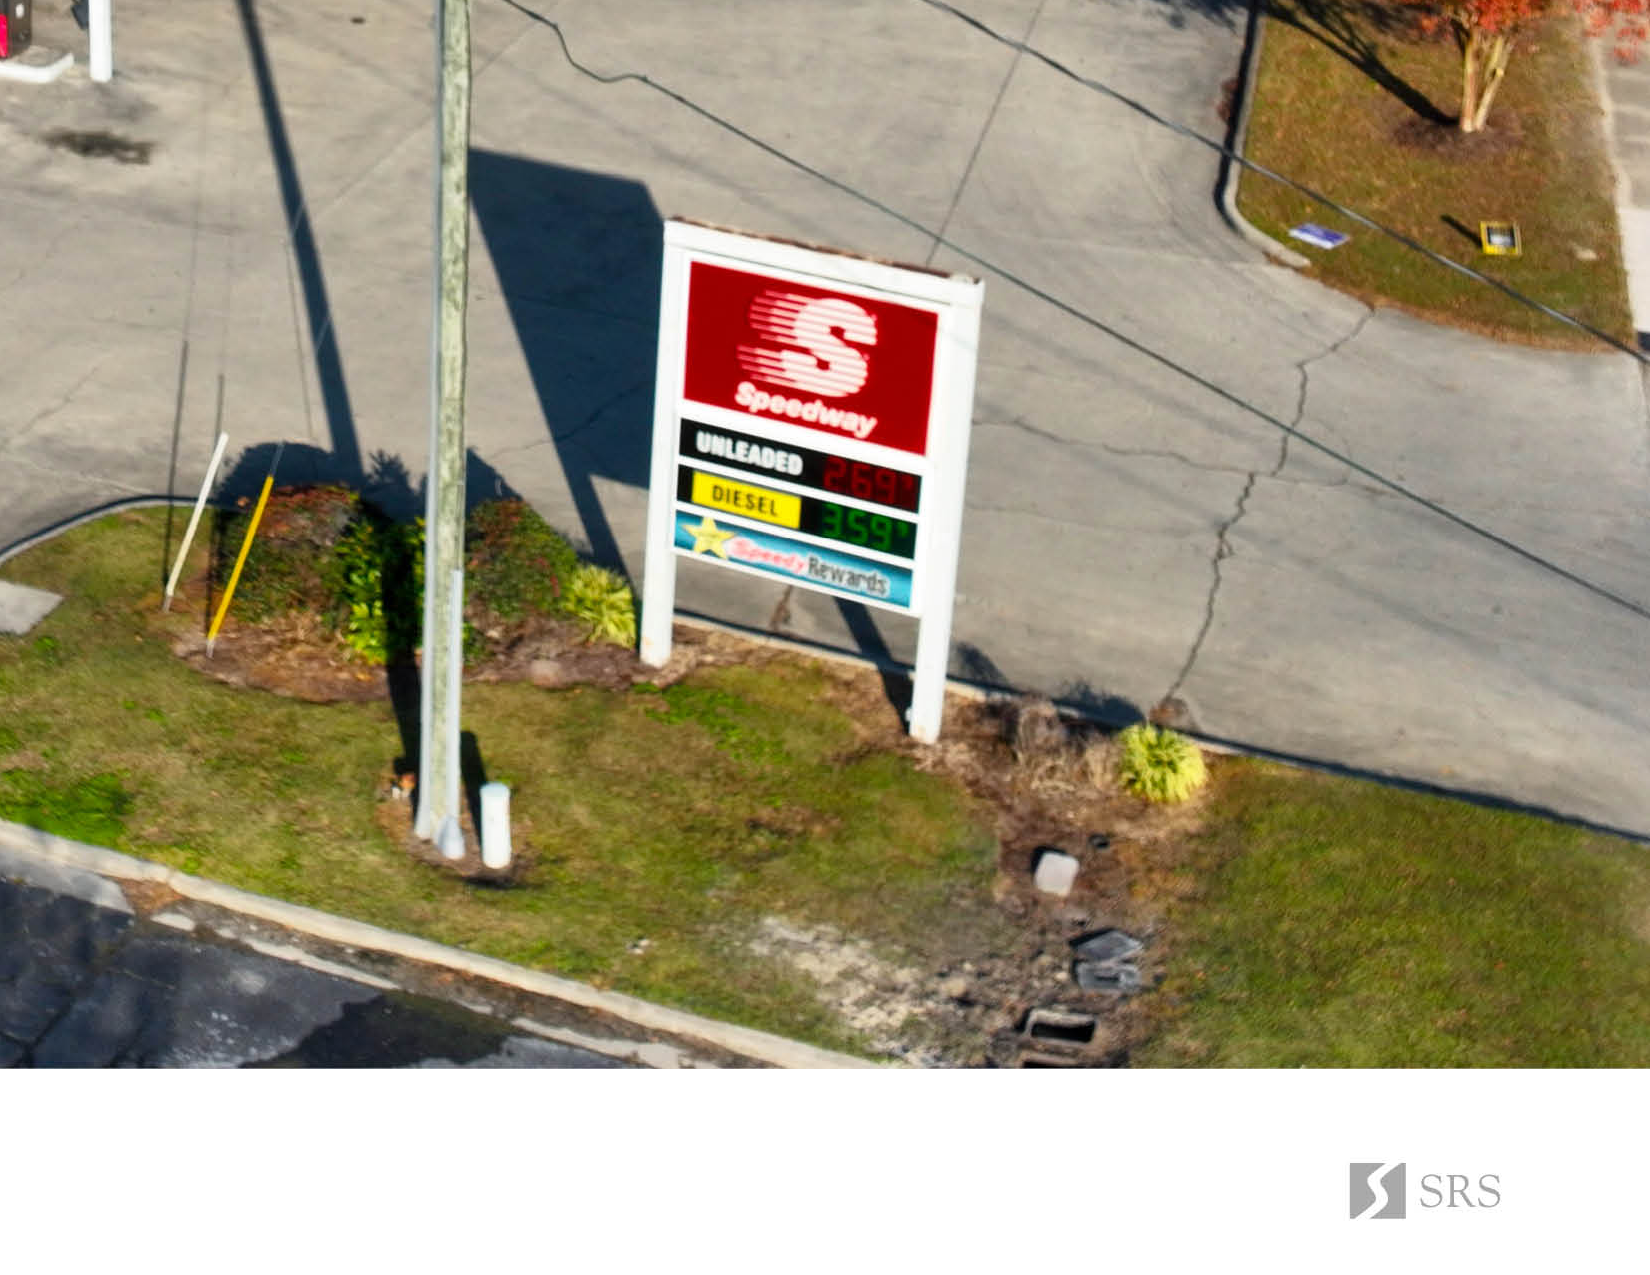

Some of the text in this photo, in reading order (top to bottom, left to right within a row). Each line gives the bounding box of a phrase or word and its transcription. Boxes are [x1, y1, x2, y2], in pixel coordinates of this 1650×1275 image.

[735, 289, 878, 398] S
[734, 381, 878, 439] Speedway
[695, 430, 804, 476] UNLEADED
[711, 484, 779, 517] DIESEL
[807, 555, 889, 596] Rewards
